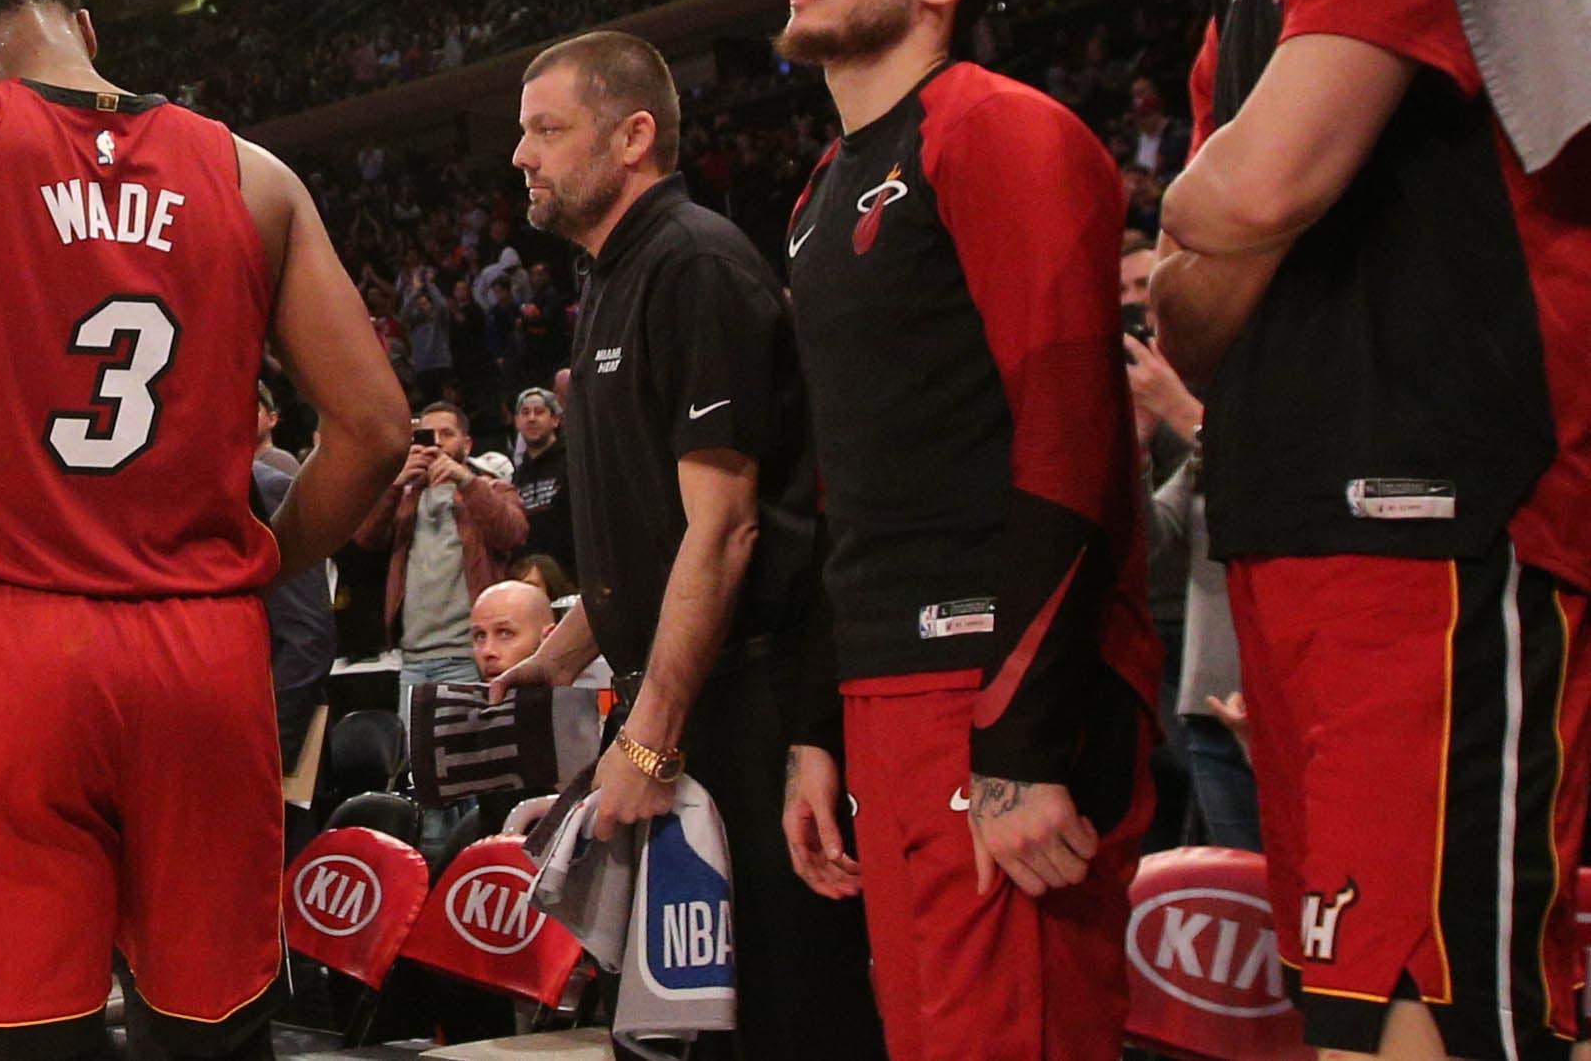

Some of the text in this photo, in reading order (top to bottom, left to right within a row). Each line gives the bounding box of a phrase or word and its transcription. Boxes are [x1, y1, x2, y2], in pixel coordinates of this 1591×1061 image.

[41, 179, 185, 252] WADE
[45, 294, 181, 474] 3
[595, 346, 622, 361] MIAMI
[597, 359, 622, 373] HEAT
[305, 865, 367, 926] KIA
[461, 879, 530, 939] KIA
[662, 900, 735, 969] NBA
[1155, 906, 1284, 997] KIA
